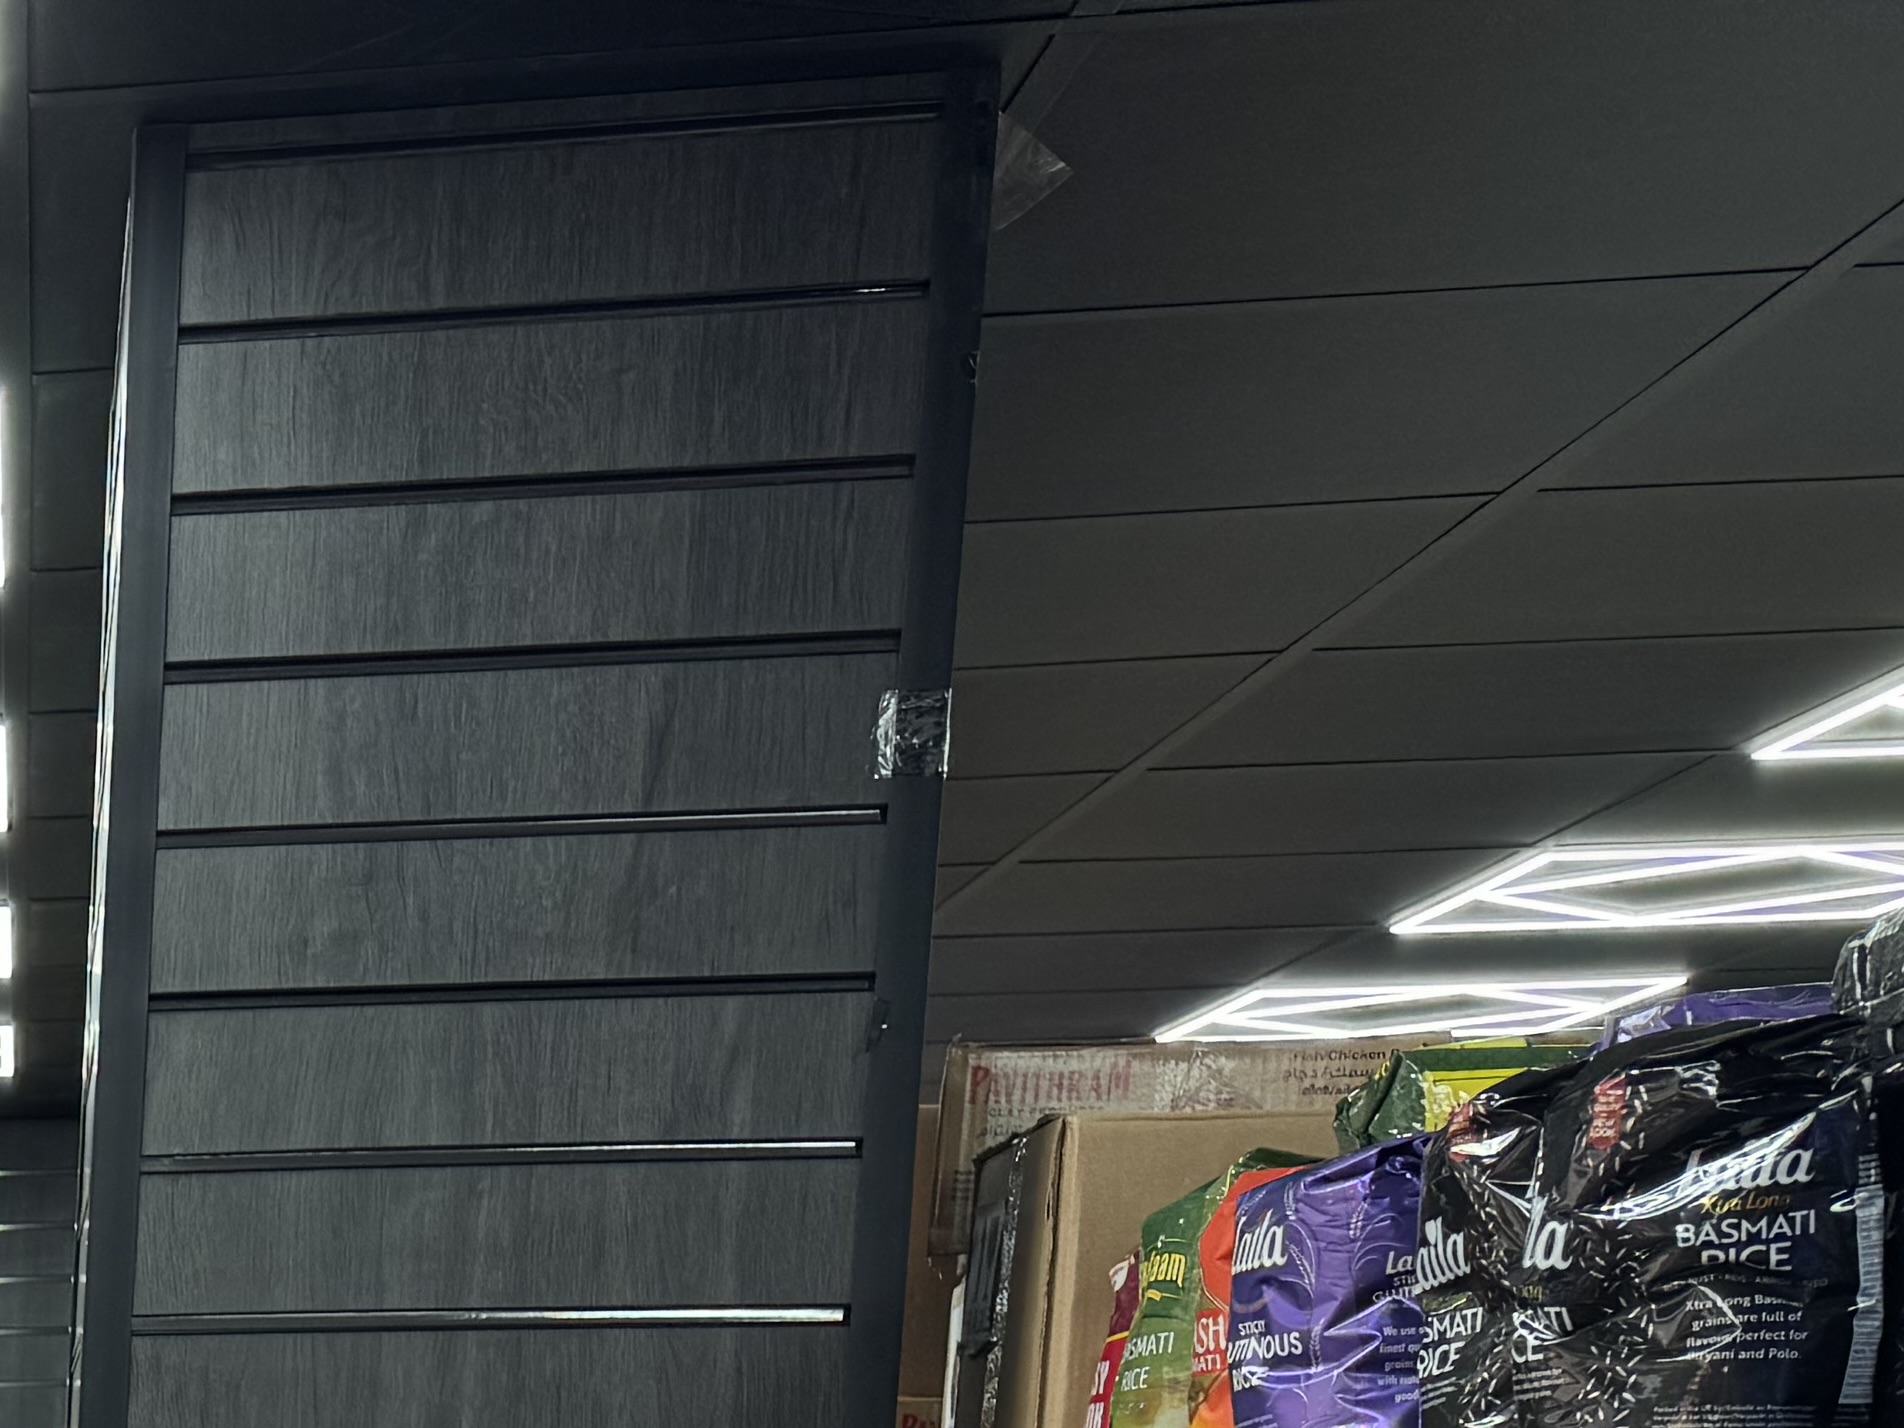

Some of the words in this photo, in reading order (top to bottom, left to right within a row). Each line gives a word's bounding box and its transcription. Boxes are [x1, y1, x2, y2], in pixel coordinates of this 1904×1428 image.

[1676, 1209, 1816, 1247] BASMATI
[1761, 1310, 1784, 1322] full
[1788, 1310, 1802, 1322] of
[1792, 1329, 1808, 1341] for
[1738, 1348, 1764, 1359] and
